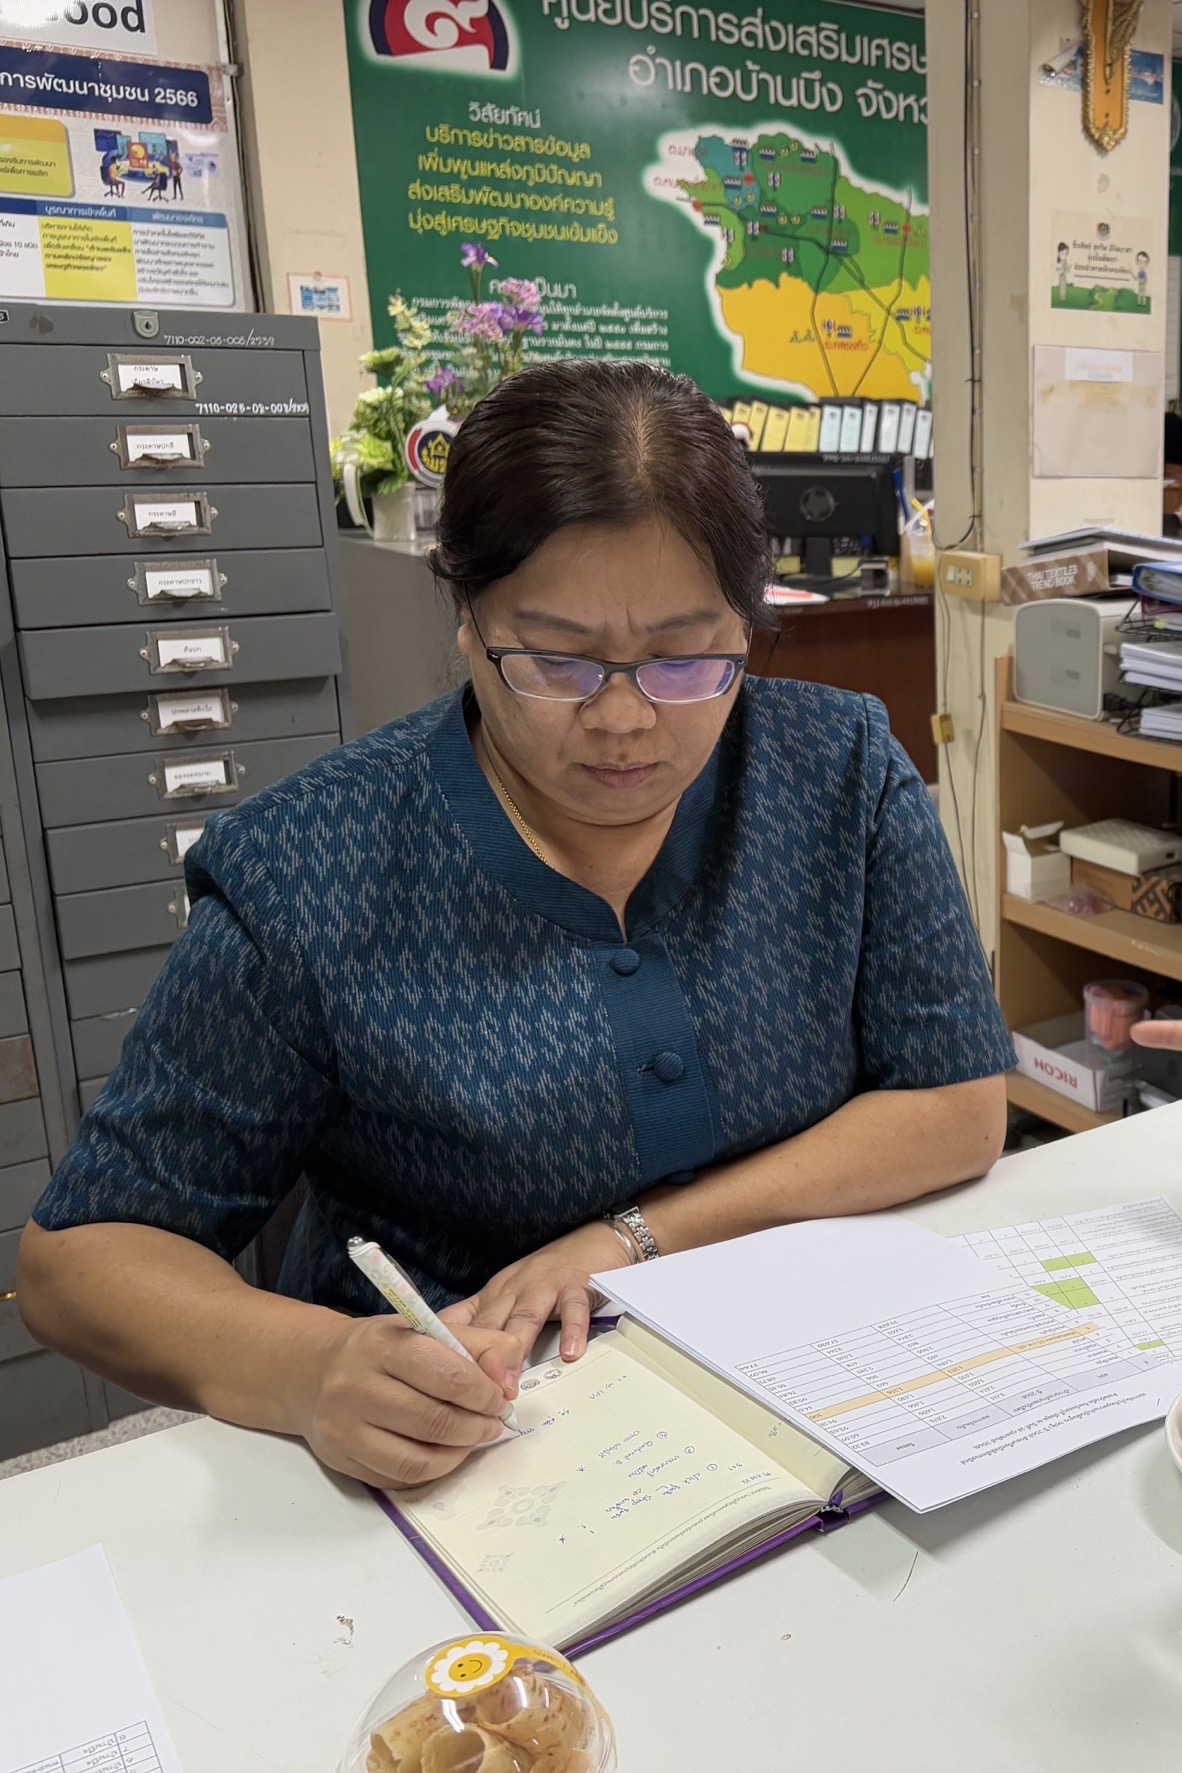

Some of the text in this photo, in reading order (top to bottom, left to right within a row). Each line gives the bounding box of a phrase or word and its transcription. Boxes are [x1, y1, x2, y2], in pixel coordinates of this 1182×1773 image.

[629, 45, 843, 112] อำเภอบ้านบึง
[154, 87, 199, 108] 2566
[468, 101, 541, 129] วิสัยทัศน์
[426, 124, 591, 162] บริการข่าวสารข้อมูล
[418, 148, 602, 188] เพิ่มพูนแหล่งภูมิปัญญา
[408, 178, 615, 222] ส่งเสริมพัฒนาองค์ความรู้
[408, 209, 618, 245] มุ่งสู่เศรษฐกิจชุมชนเข้มแข็ง
[1028, 564, 1078, 581] THAI TEXTILES
[1031, 575, 1076, 590] TREND BOOK
[1033, 1057, 1077, 1089] RICOH
[808, 1411, 822, 1421] 100
